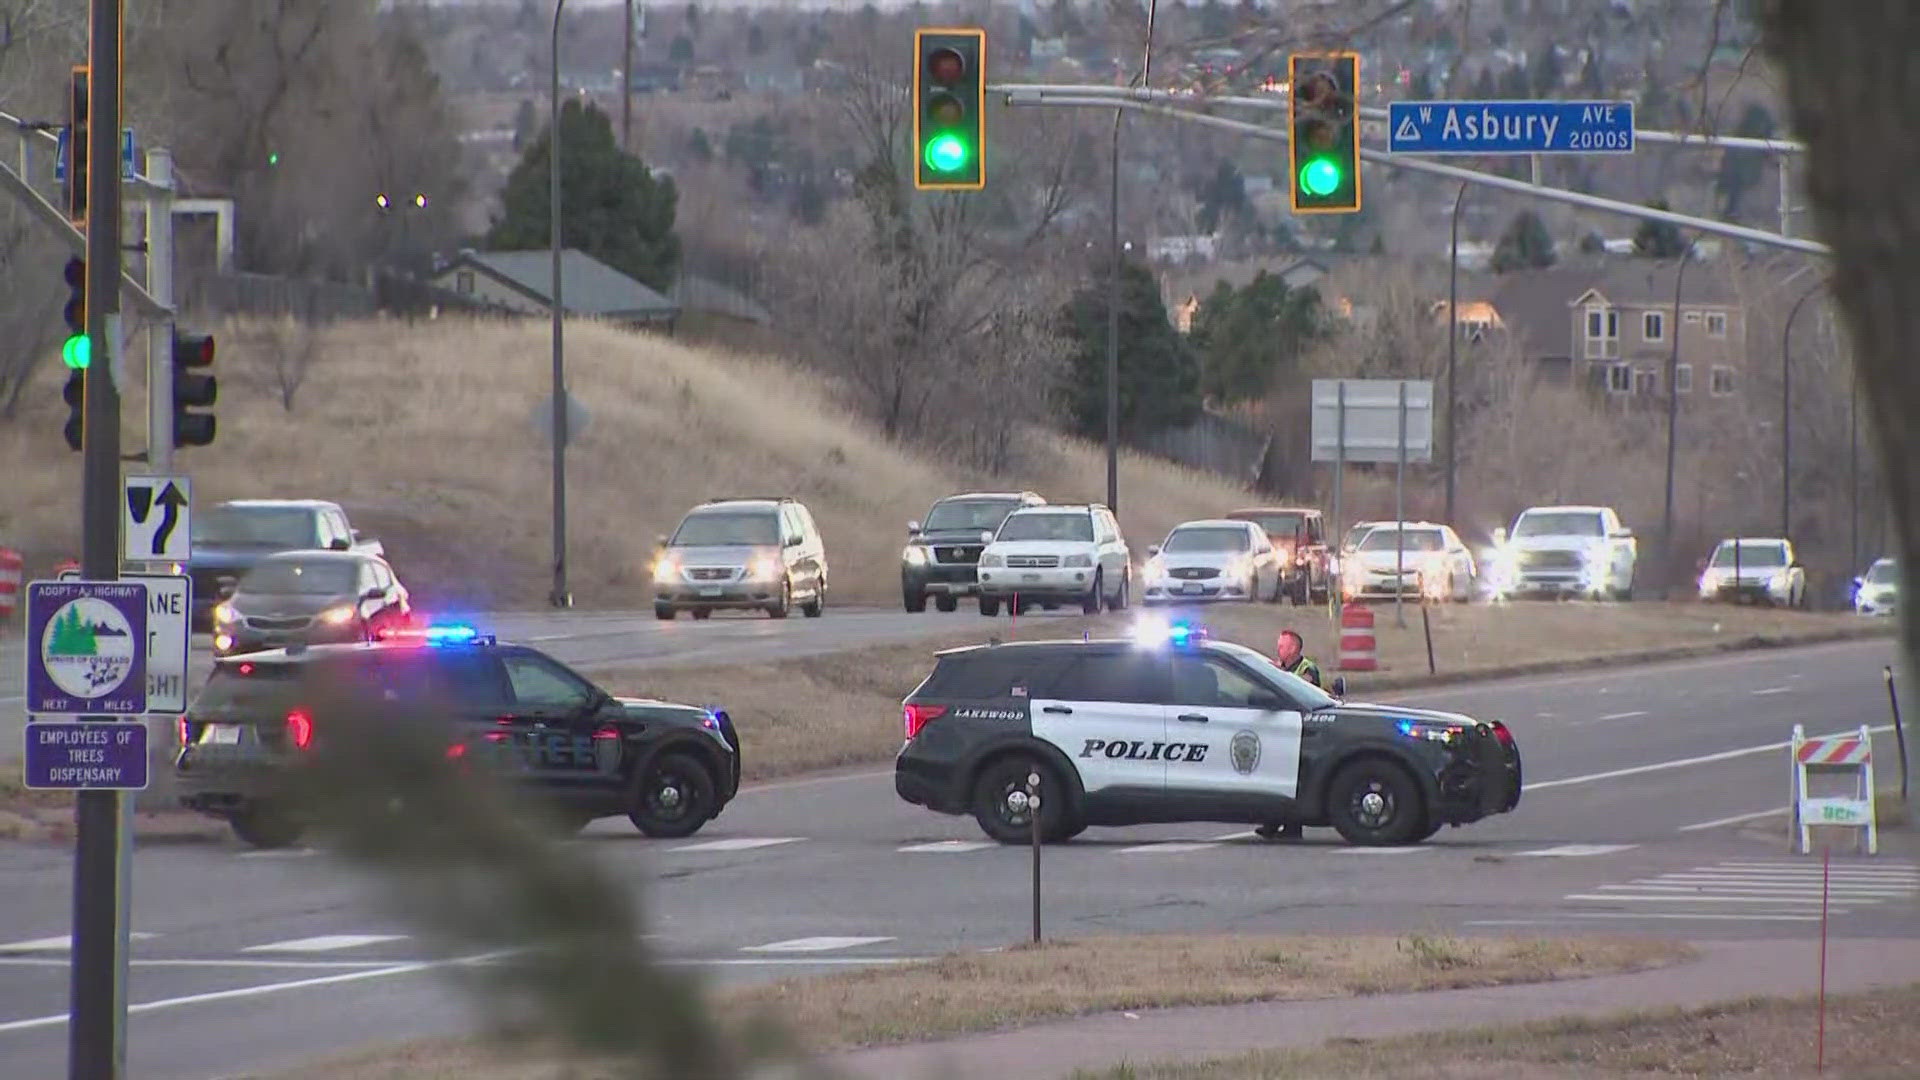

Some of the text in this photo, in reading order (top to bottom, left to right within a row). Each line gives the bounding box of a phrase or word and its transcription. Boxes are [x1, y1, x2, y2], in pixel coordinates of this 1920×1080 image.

[1442, 107, 1559, 148] Asbury
[1582, 105, 1615, 123] AVE
[1569, 131, 1628, 149] 2000S
[42, 700, 68, 710] NEXT
[104, 700, 133, 710] MILES
[955, 708, 1024, 720] LAKEWOOD
[39, 730, 132, 744] EMPLOYEES OF
[68, 750, 104, 762] TREES
[1079, 739, 1209, 762] POLICE
[49, 768, 121, 781] DISPENSARY
